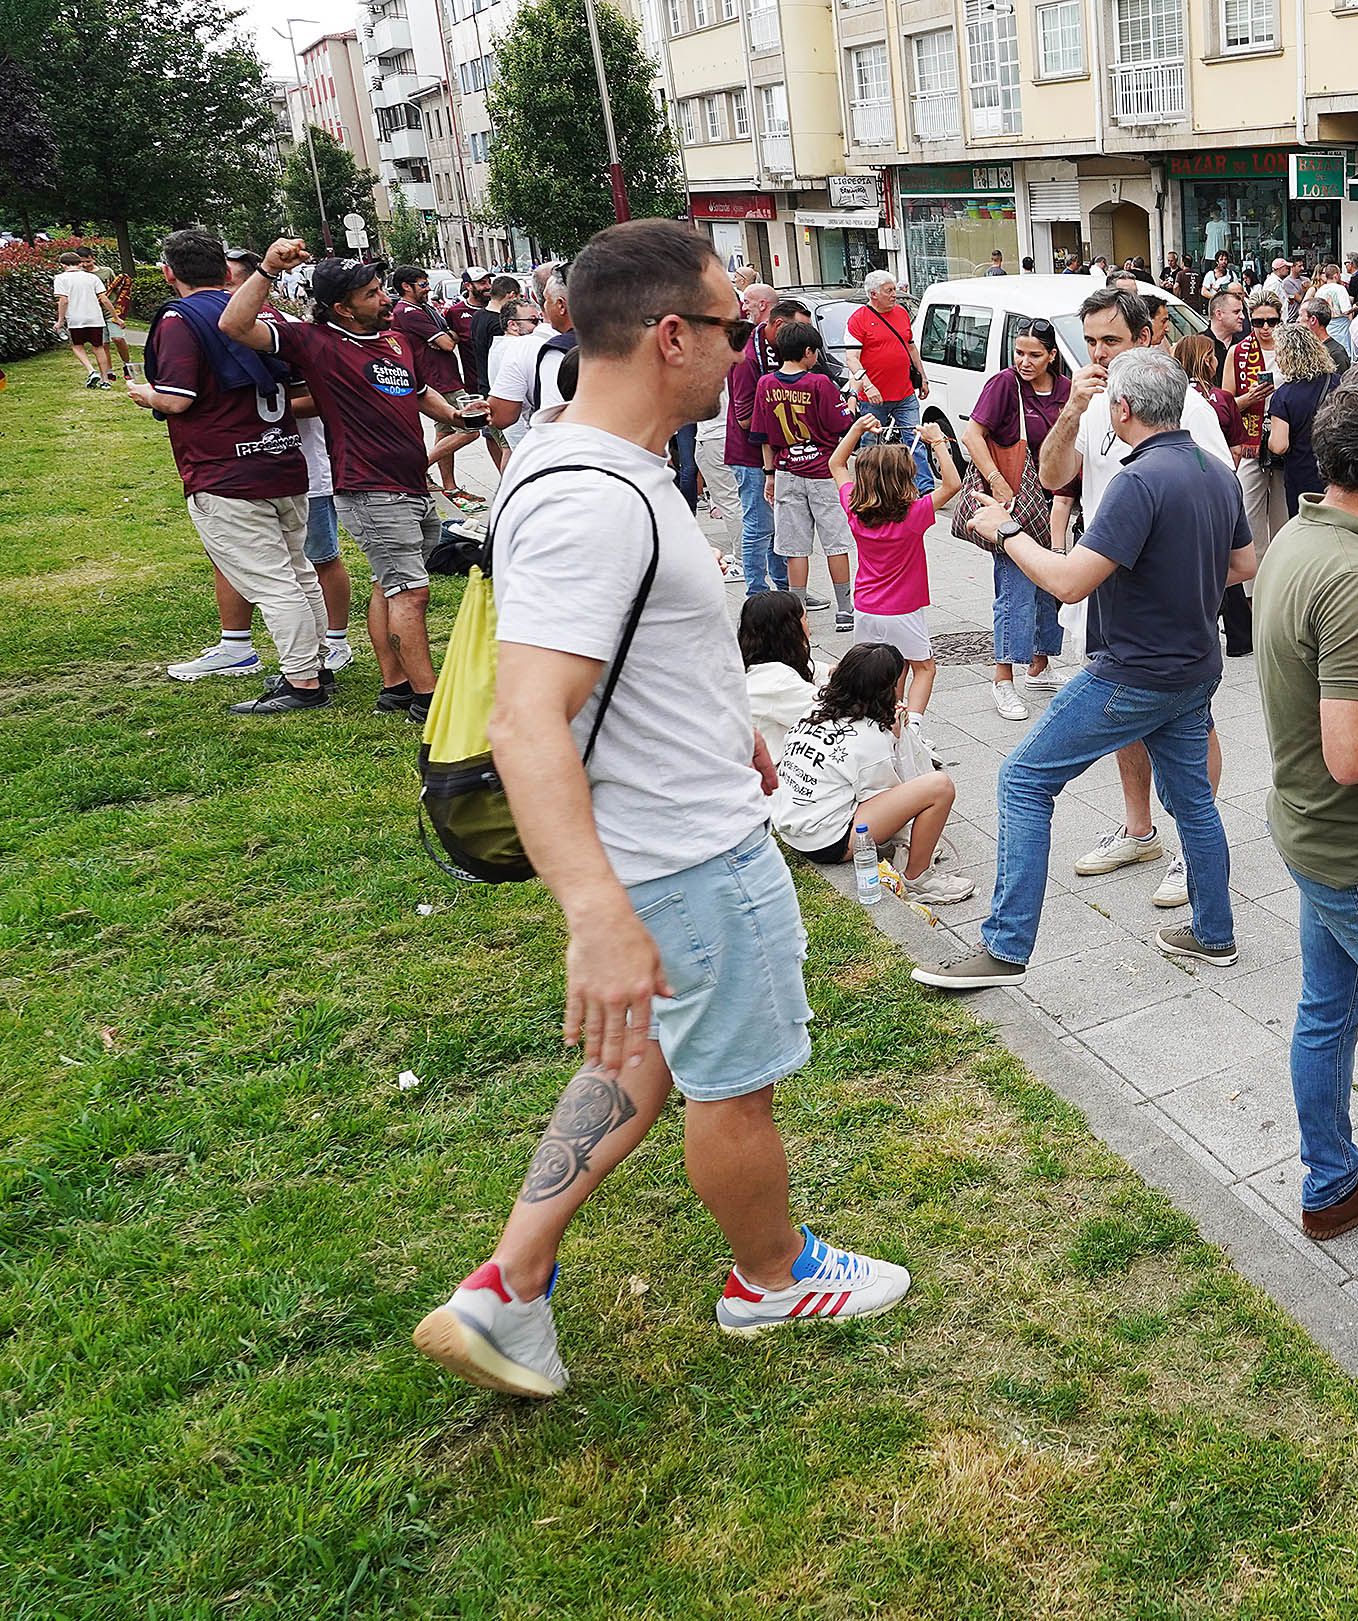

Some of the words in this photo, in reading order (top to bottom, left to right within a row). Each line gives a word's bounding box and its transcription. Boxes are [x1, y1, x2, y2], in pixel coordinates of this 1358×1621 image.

[1170, 155, 1227, 174] BAZAR
[1303, 183, 1339, 197] LONG
[372, 364, 409, 378] Estrella
[376, 374, 410, 388] Galicia
[773, 389, 812, 405] RODRIGUEZ
[773, 403, 811, 447] 15
